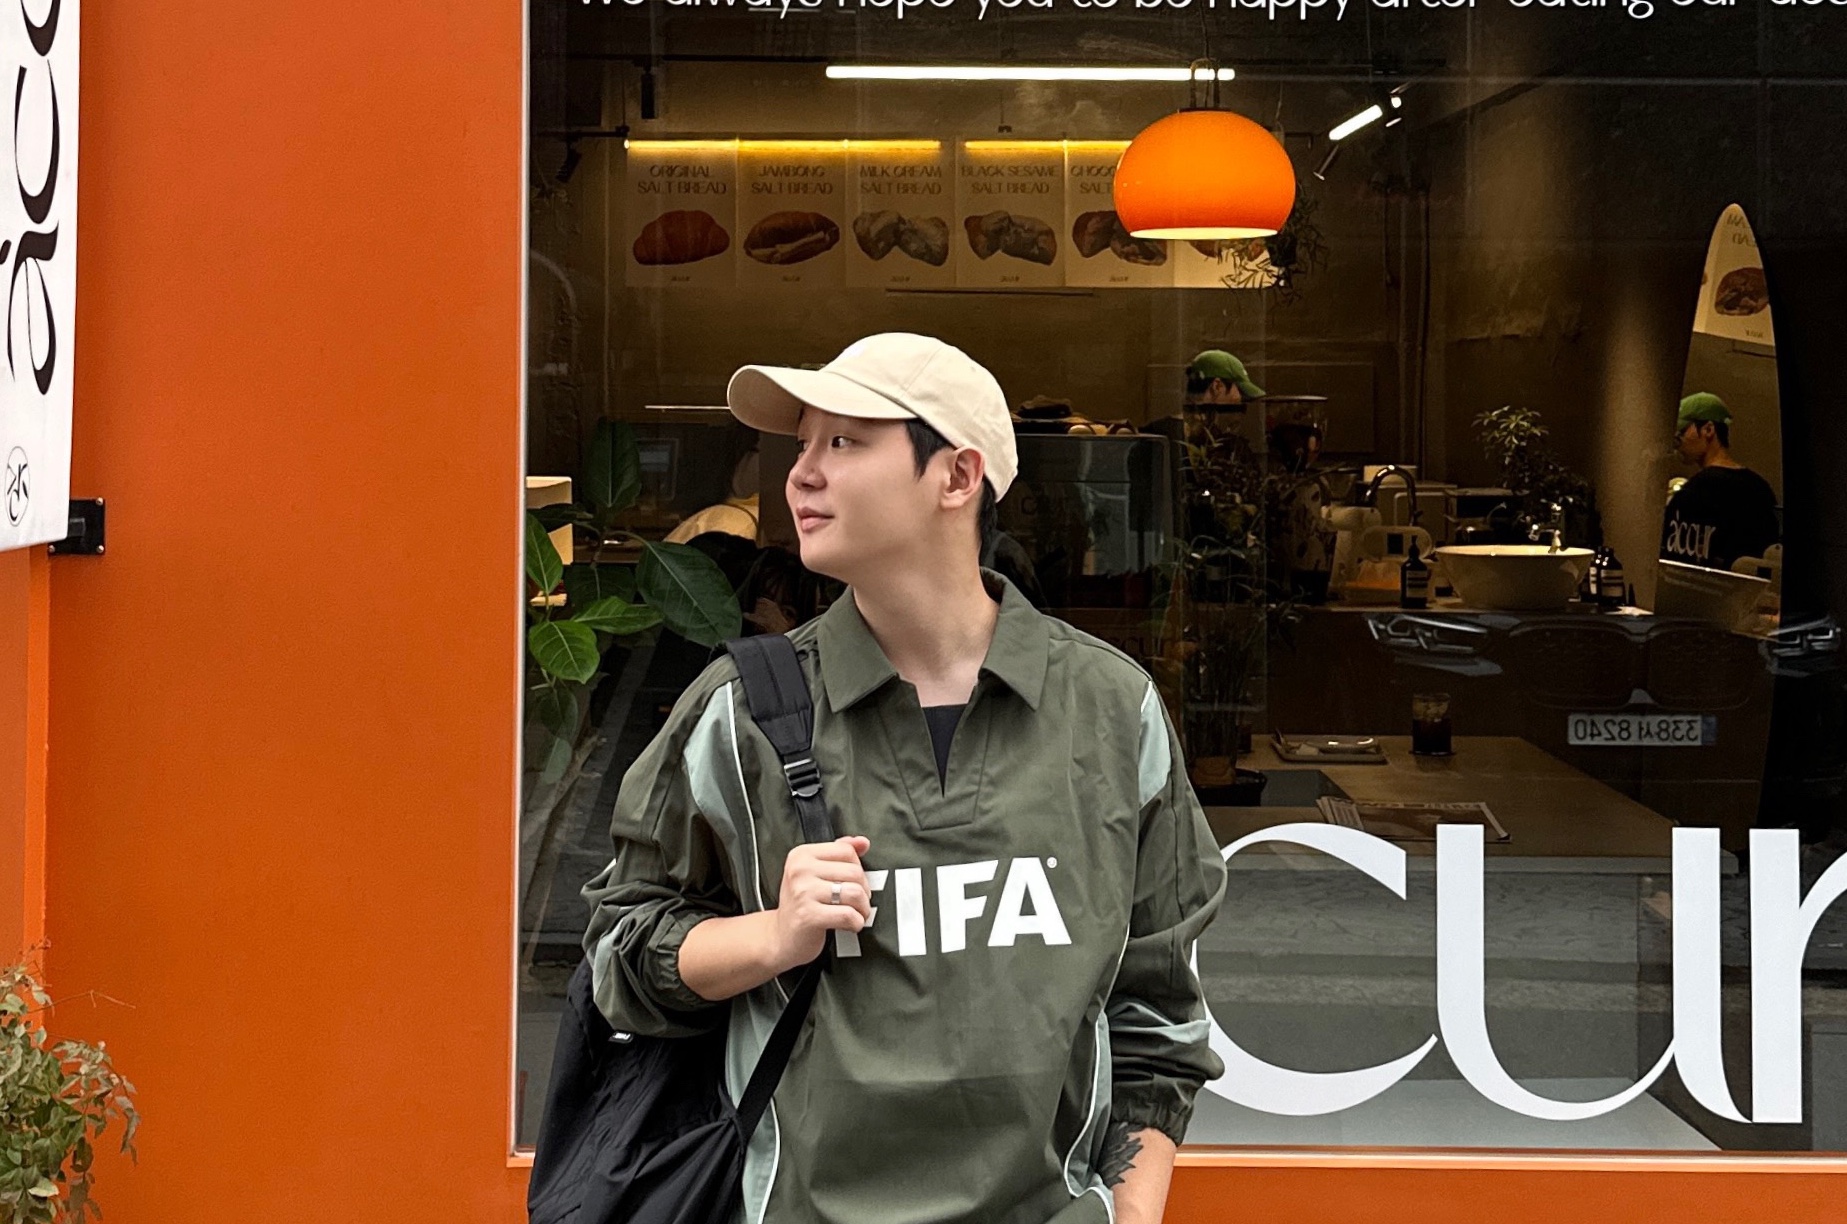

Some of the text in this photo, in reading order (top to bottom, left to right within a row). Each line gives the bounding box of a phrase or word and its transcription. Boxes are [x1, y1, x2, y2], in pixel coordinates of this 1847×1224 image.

[649, 164, 712, 178] ORIGINAL
[859, 165, 942, 179] MILK CREAM
[961, 165, 1057, 178] BLACK SESAME
[638, 181, 727, 195] SALT BREAD
[751, 182, 834, 195] SALT BREAD
[860, 182, 942, 195] SALT BREAD
[971, 182, 1050, 195] SALT BREAD
[1080, 182, 1113, 195] SALT
